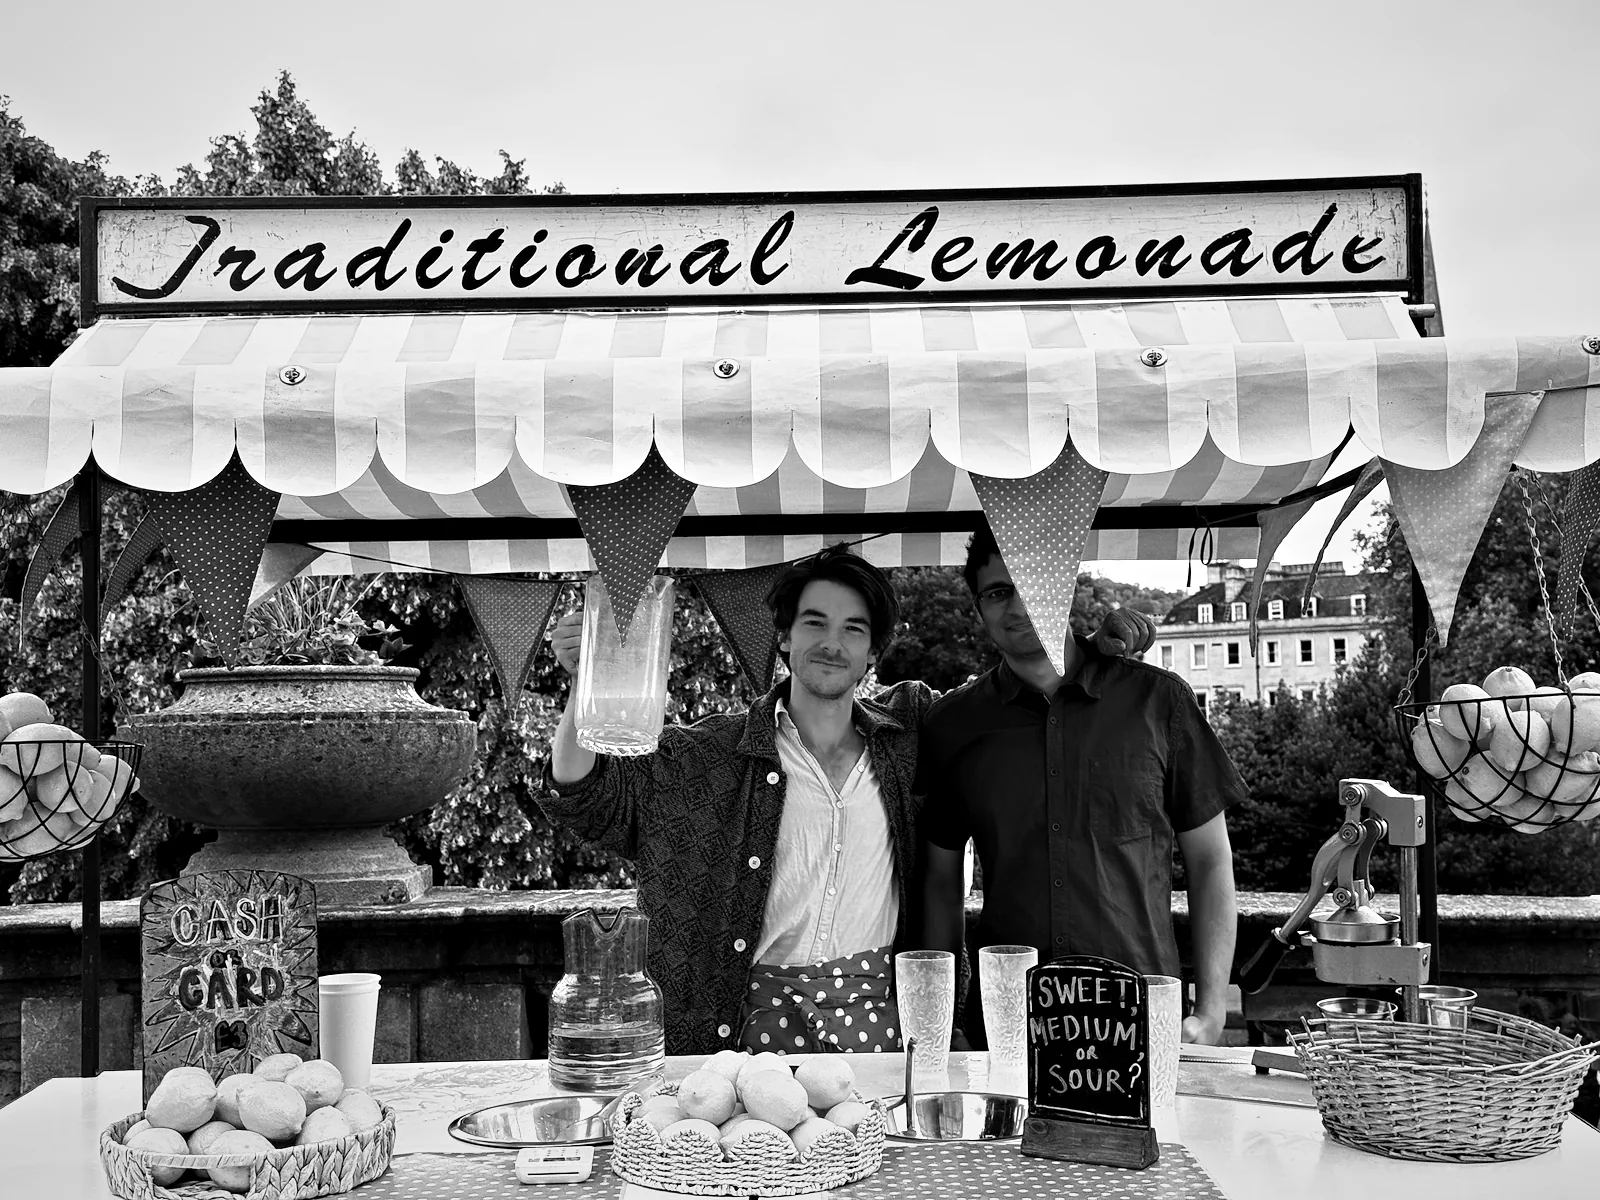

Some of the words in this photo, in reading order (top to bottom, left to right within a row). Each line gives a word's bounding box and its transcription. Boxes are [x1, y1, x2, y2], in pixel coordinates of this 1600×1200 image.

[112, 211, 796, 299] Traditional
[844, 203, 1388, 290] Lemonade
[171, 894, 284, 945] CASH
[178, 966, 285, 1011] CARD
[1075, 1045, 1099, 1060] OR
[1048, 1062, 1142, 1099] SOUR?
